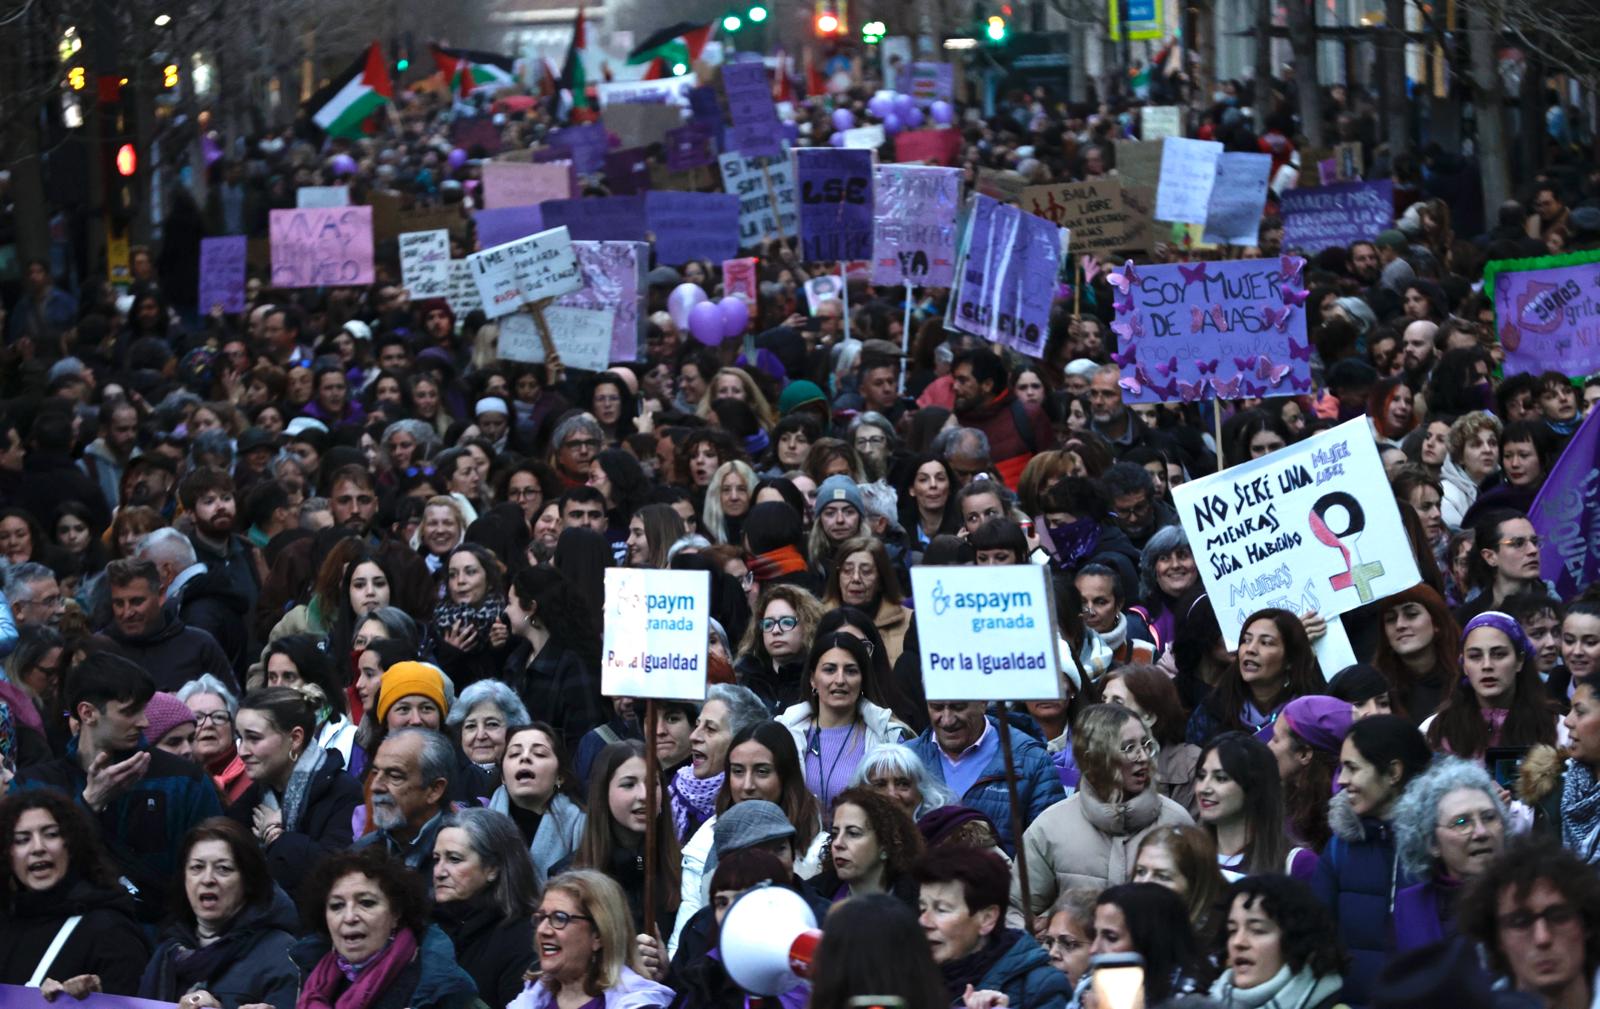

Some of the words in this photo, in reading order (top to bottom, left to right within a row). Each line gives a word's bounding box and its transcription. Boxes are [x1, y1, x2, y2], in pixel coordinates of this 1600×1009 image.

[897, 250, 929, 276] YA
[1141, 275, 1187, 307] SOY
[1202, 271, 1284, 303] MUJER
[1150, 310, 1181, 337] DE
[1201, 306, 1268, 334] ALAS
[1193, 494, 1229, 533] NO
[1233, 473, 1275, 516] SERÉ
[1277, 463, 1314, 494] UNA
[1311, 439, 1352, 469] MUJER
[1206, 502, 1281, 551] MIENRAS
[1245, 530, 1303, 565] HABIENDO
[1229, 561, 1294, 608] MUJERES
[631, 592, 695, 614] paym
[954, 590, 1033, 613] aspaym
[645, 616, 694, 632] ranada
[971, 613, 1035, 633] granada
[640, 651, 699, 674] Igualdad
[930, 652, 954, 671] Por
[959, 652, 973, 670] la
[976, 651, 1047, 675] Igualdad
